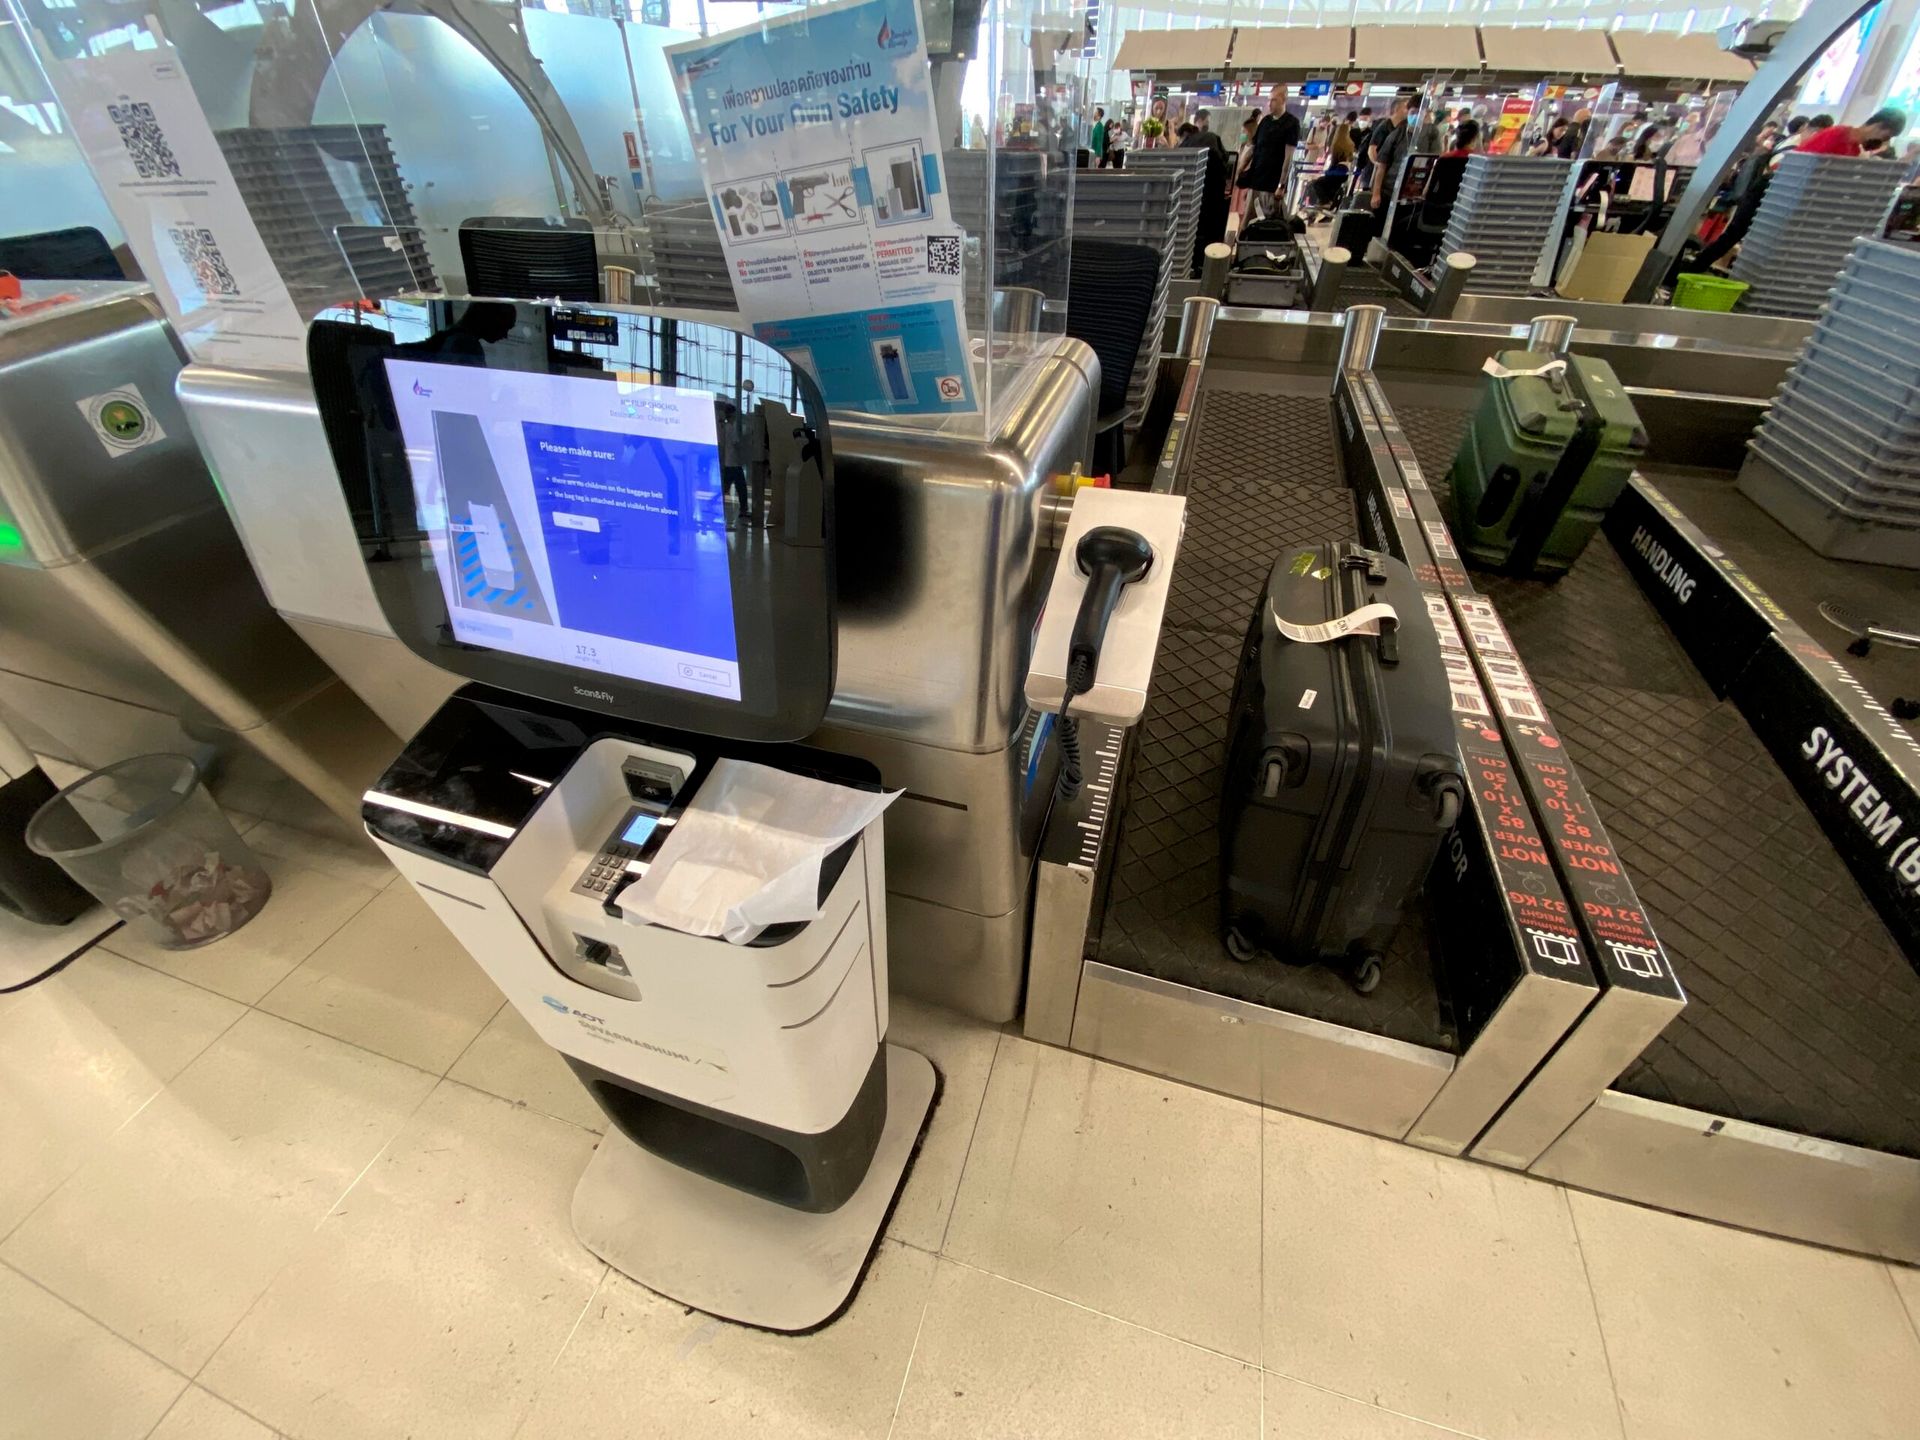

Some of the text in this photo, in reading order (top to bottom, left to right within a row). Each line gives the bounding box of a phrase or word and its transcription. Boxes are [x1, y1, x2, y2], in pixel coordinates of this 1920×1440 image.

[722, 60, 872, 110] เพื่อความปลอดภัยของท่าน
[708, 121, 737, 146] For
[740, 111, 785, 139] Your
[837, 85, 899, 119] Safety
[876, 246, 913, 259] PERMITTED
[540, 441, 615, 460] Please make sure:
[1631, 525, 1697, 604] HANDLING
[575, 645, 597, 658] 17.3
[573, 685, 614, 704] Scan&Fly
[1472, 756, 1507, 768] cm.
[1531, 762, 1567, 775] cm.
[1482, 770, 1507, 783] 50
[1543, 777, 1569, 791] 50
[1802, 726, 1903, 847] SYSTEM
[1483, 790, 1521, 807] 110
[1545, 797, 1586, 814] 110
[1498, 815, 1526, 830] 85
[1563, 823, 1592, 838] 85
[1494, 830, 1541, 847] OVER
[1560, 838, 1609, 856] OVER
[1500, 845, 1549, 866] NOT
[1569, 854, 1619, 875] NOT
[1508, 891, 1568, 914] 32 KG
[1519, 908, 1567, 925] WEIGHT
[1583, 902, 1644, 925] 32 KG
[1597, 919, 1645, 936] WEIGHT
